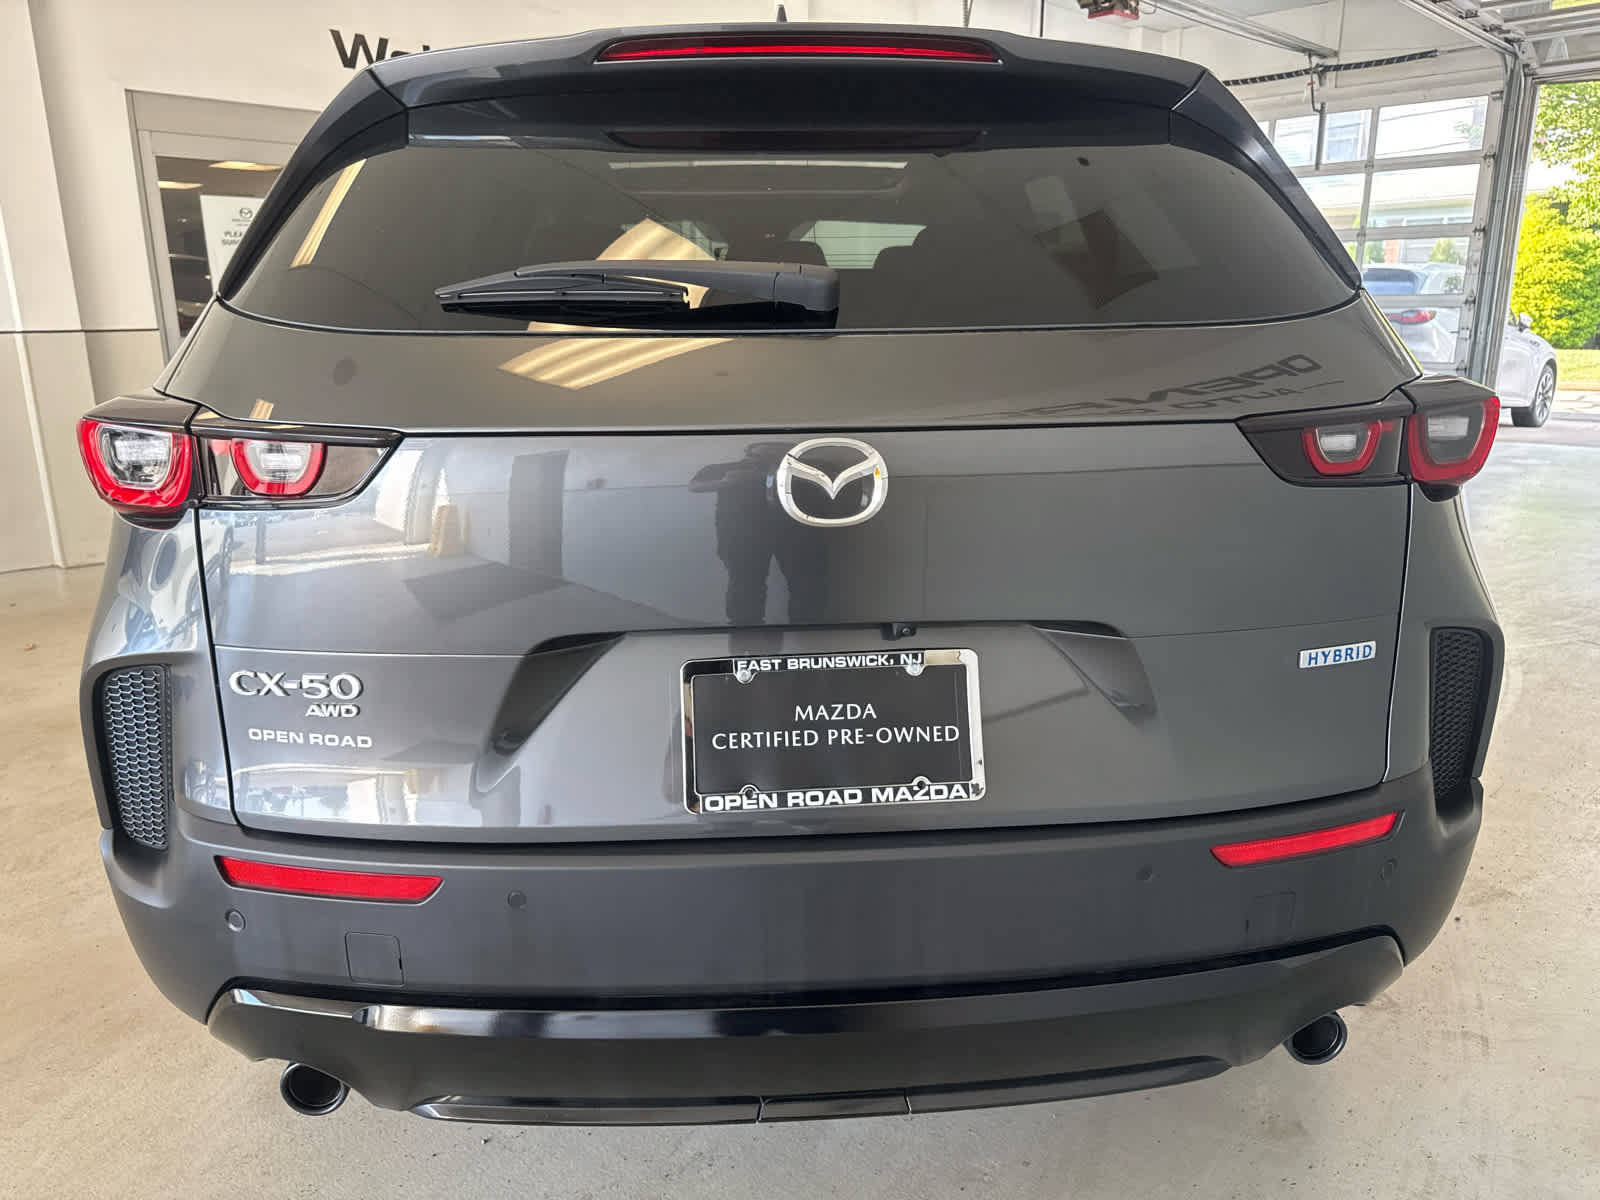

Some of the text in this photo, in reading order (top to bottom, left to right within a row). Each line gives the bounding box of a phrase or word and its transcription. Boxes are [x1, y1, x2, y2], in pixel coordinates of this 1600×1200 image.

[737, 653, 922, 671] EAST BRUNSWICK, NJ
[1307, 644, 1373, 666] HYBRID
[229, 670, 363, 700] CX-50
[305, 703, 360, 717] AWD
[794, 703, 877, 722] MAZDA
[248, 728, 373, 749] OPEN ROAD
[711, 725, 960, 750] CERTIFIED PRE-OWNED
[704, 783, 968, 811] OPEN ROAD MAZDA
